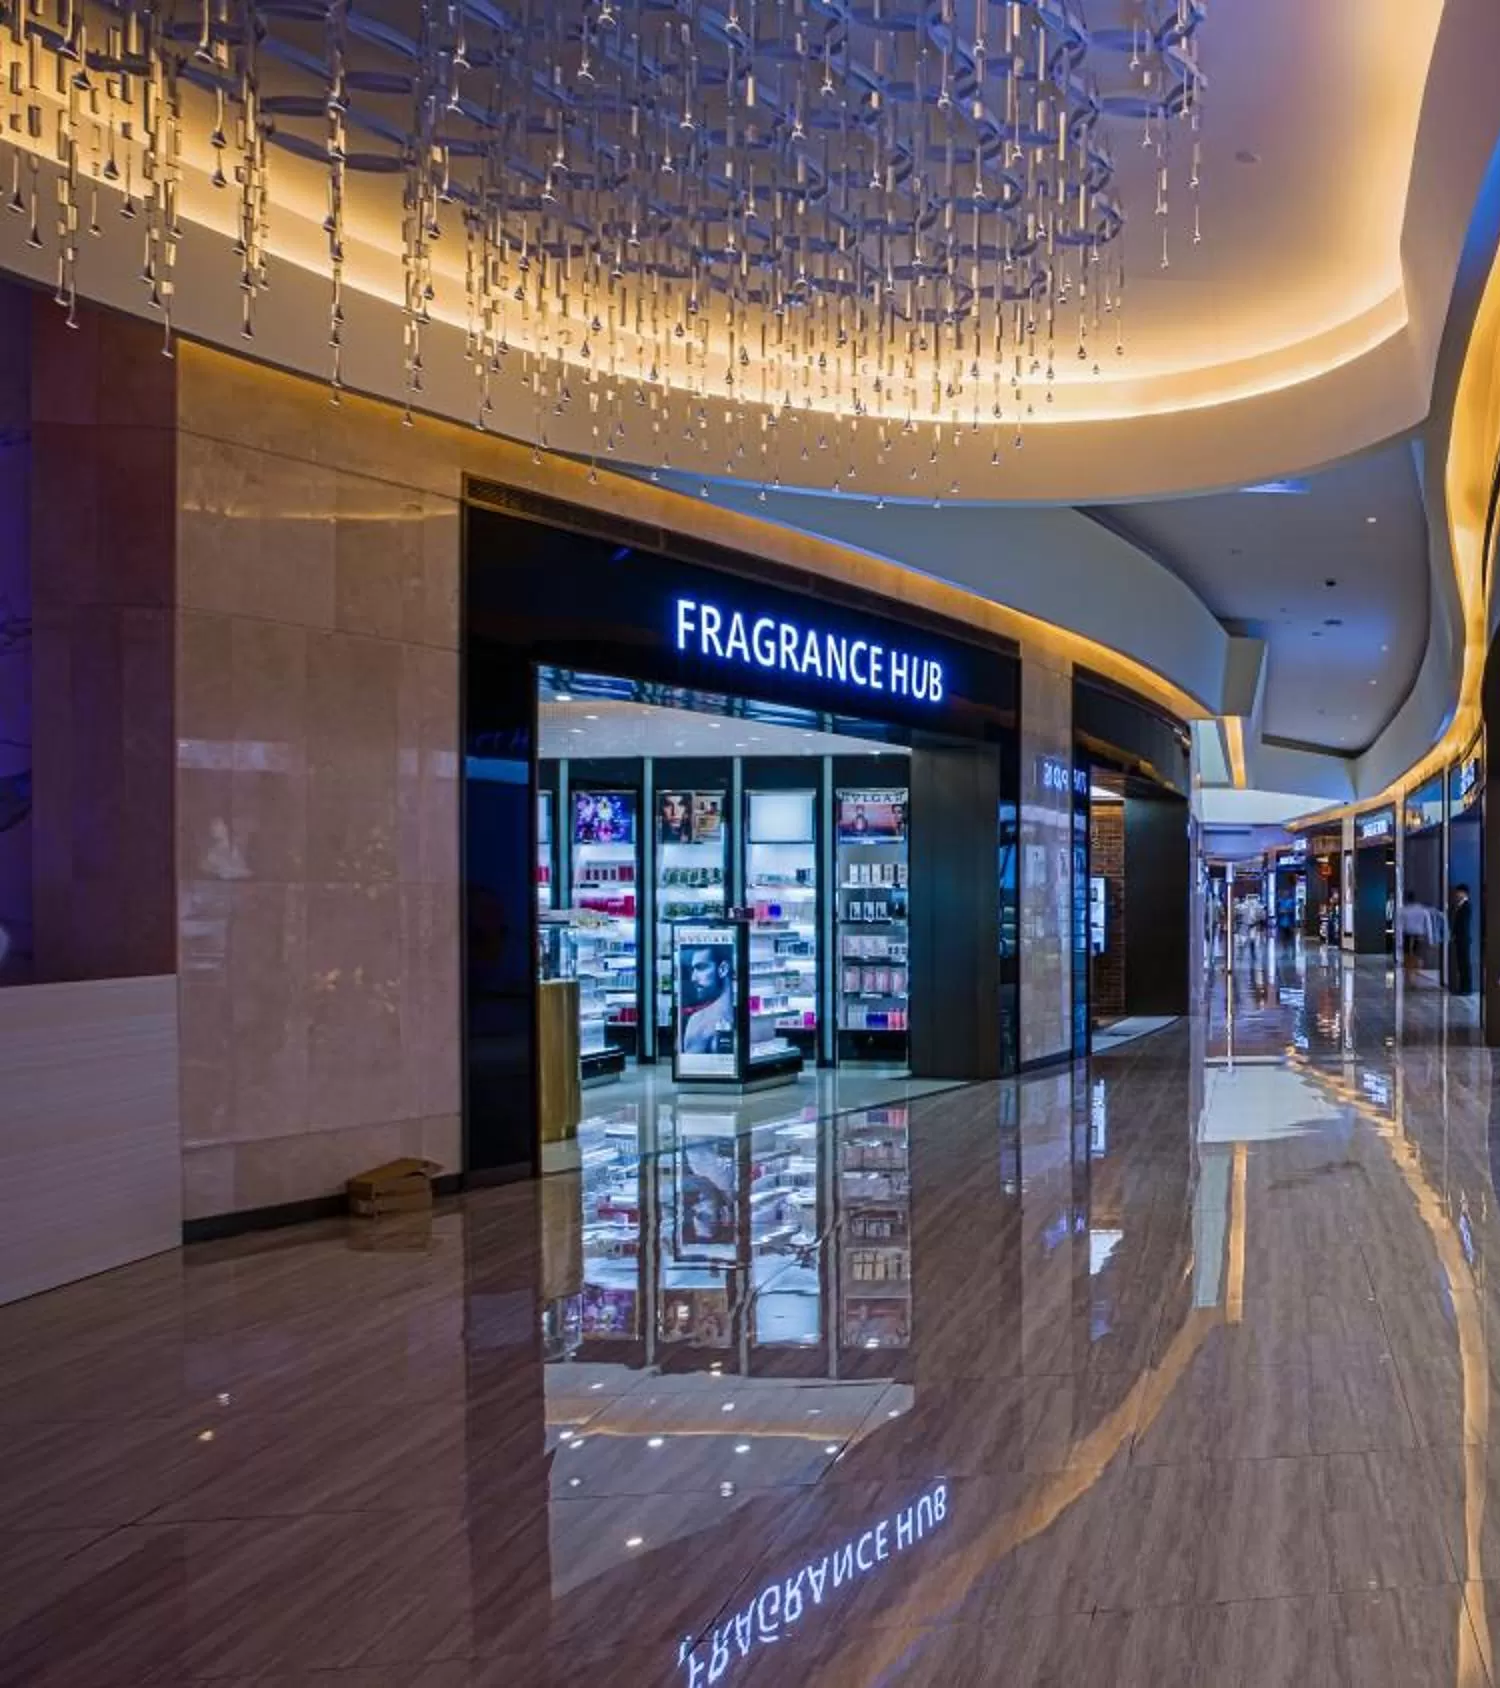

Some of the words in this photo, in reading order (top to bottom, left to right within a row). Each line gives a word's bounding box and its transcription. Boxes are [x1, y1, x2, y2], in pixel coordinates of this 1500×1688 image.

[676, 599, 884, 689] FRAGRANCE
[890, 650, 944, 702] HUB
[842, 793, 903, 803] BVLGAR
